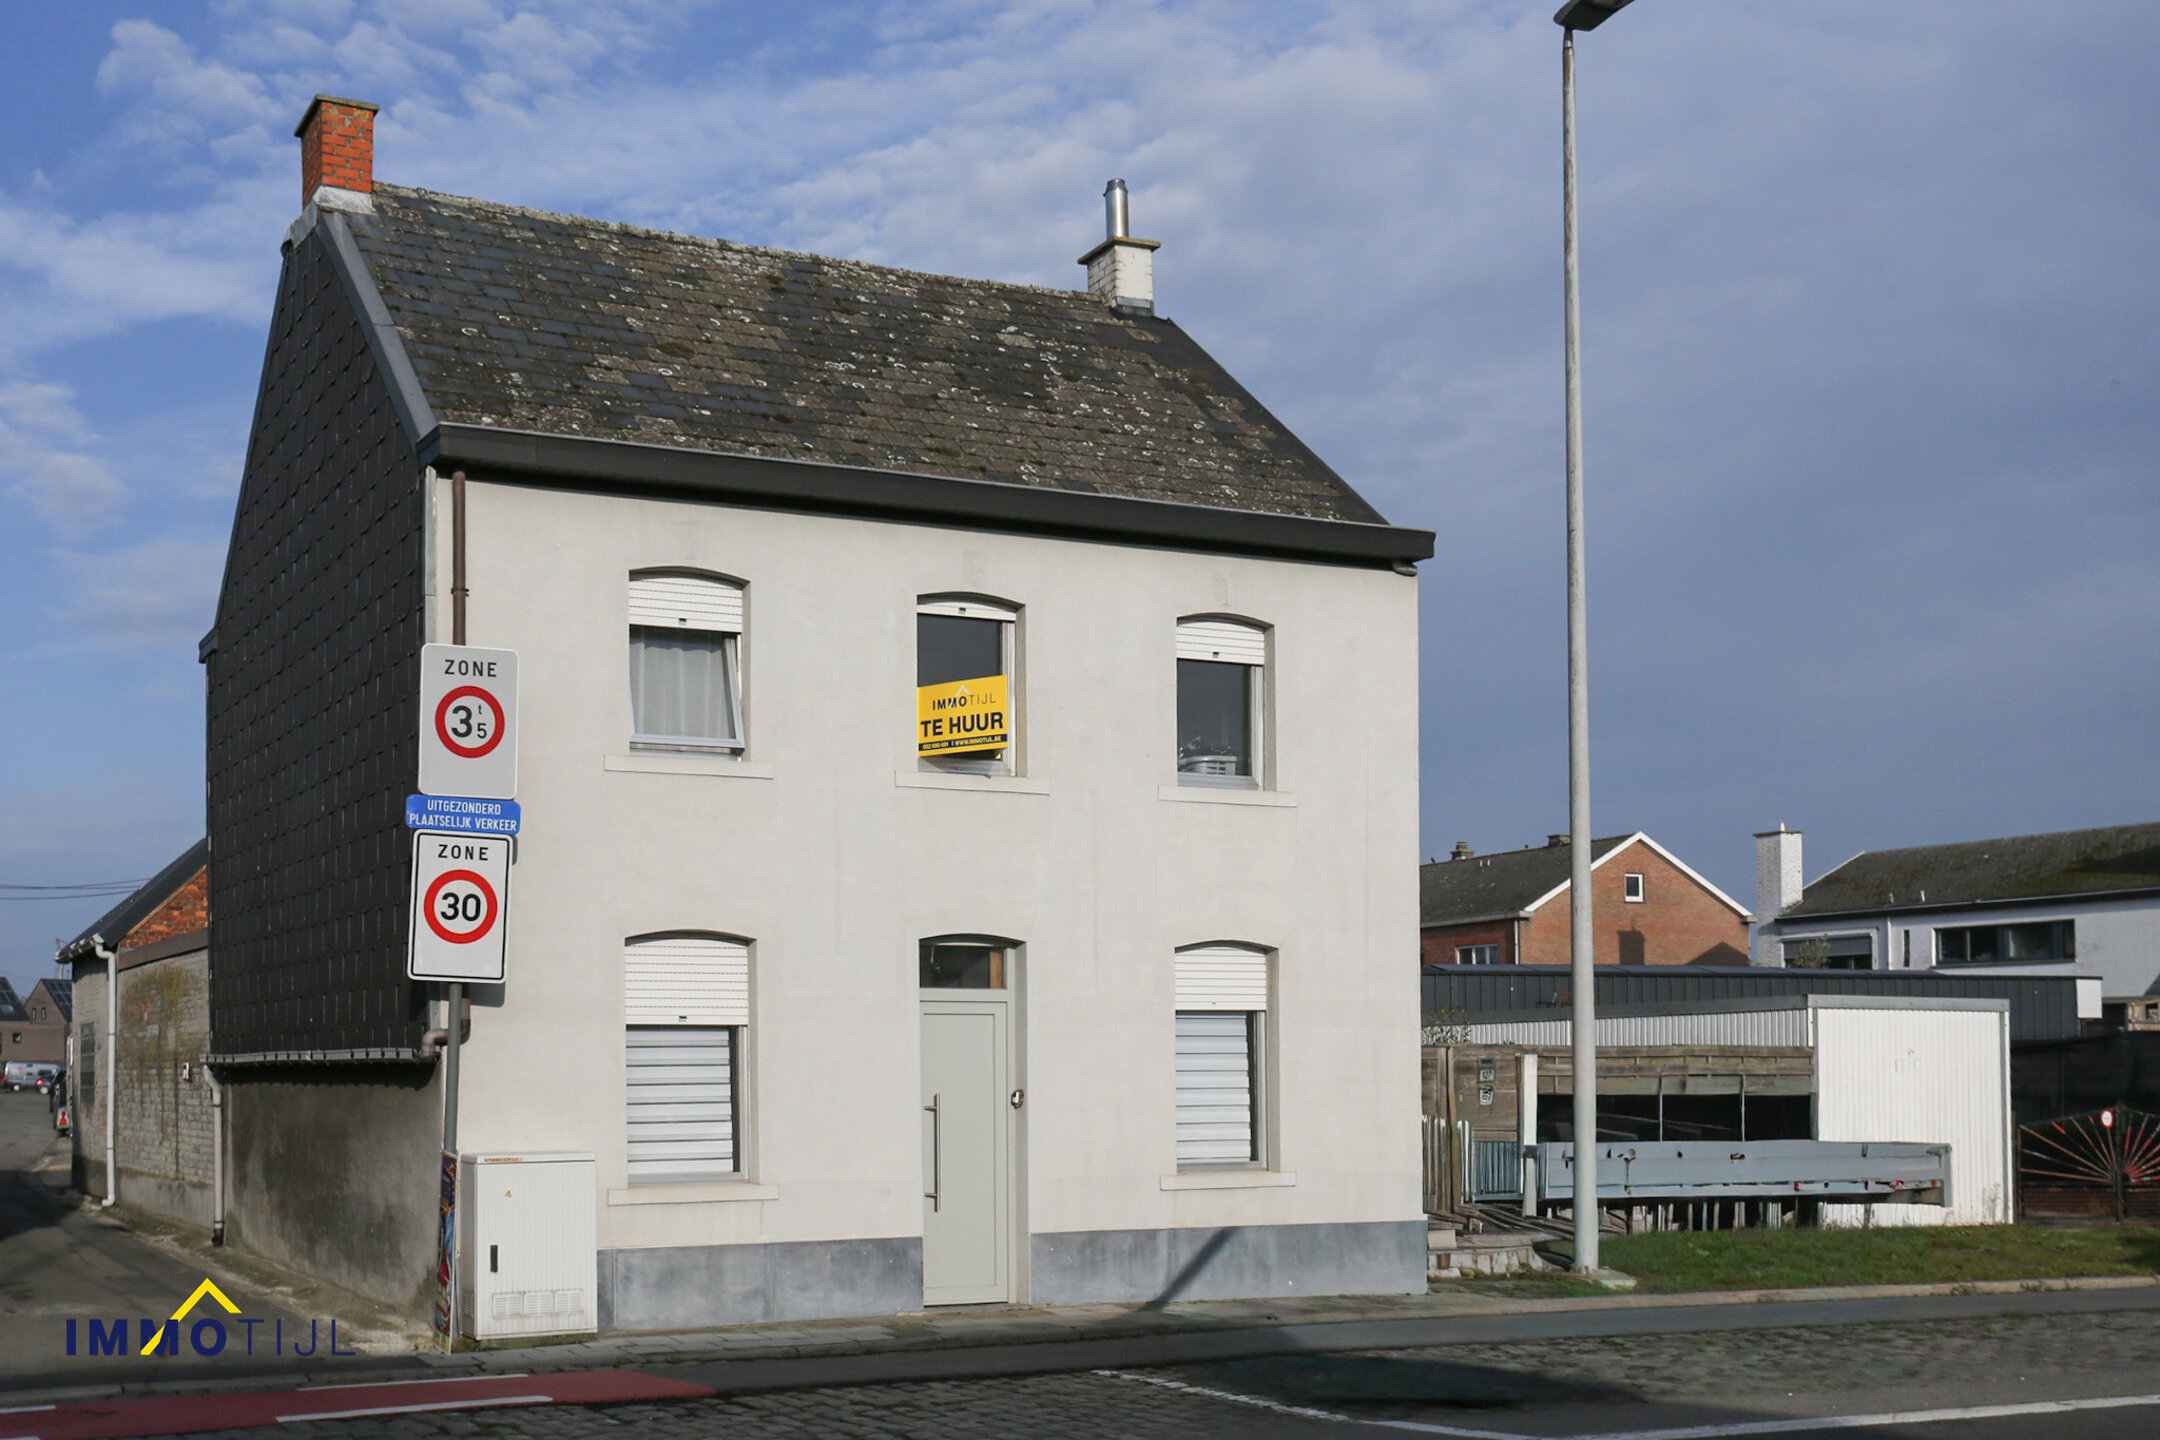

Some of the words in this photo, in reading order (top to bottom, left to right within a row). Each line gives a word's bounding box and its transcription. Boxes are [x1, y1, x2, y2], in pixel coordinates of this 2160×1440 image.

[444, 659, 498, 678] ZONE
[932, 693, 996, 711] IMMOTIJL
[920, 718, 943, 738] TE
[949, 712, 1004, 735] HUUR
[427, 799, 502, 816] UITGEZONDERD
[409, 813, 472, 830] PLAATSELIJK
[474, 817, 518, 832] VERKEER
[438, 844, 490, 862] ZONE
[440, 891, 482, 922] 30
